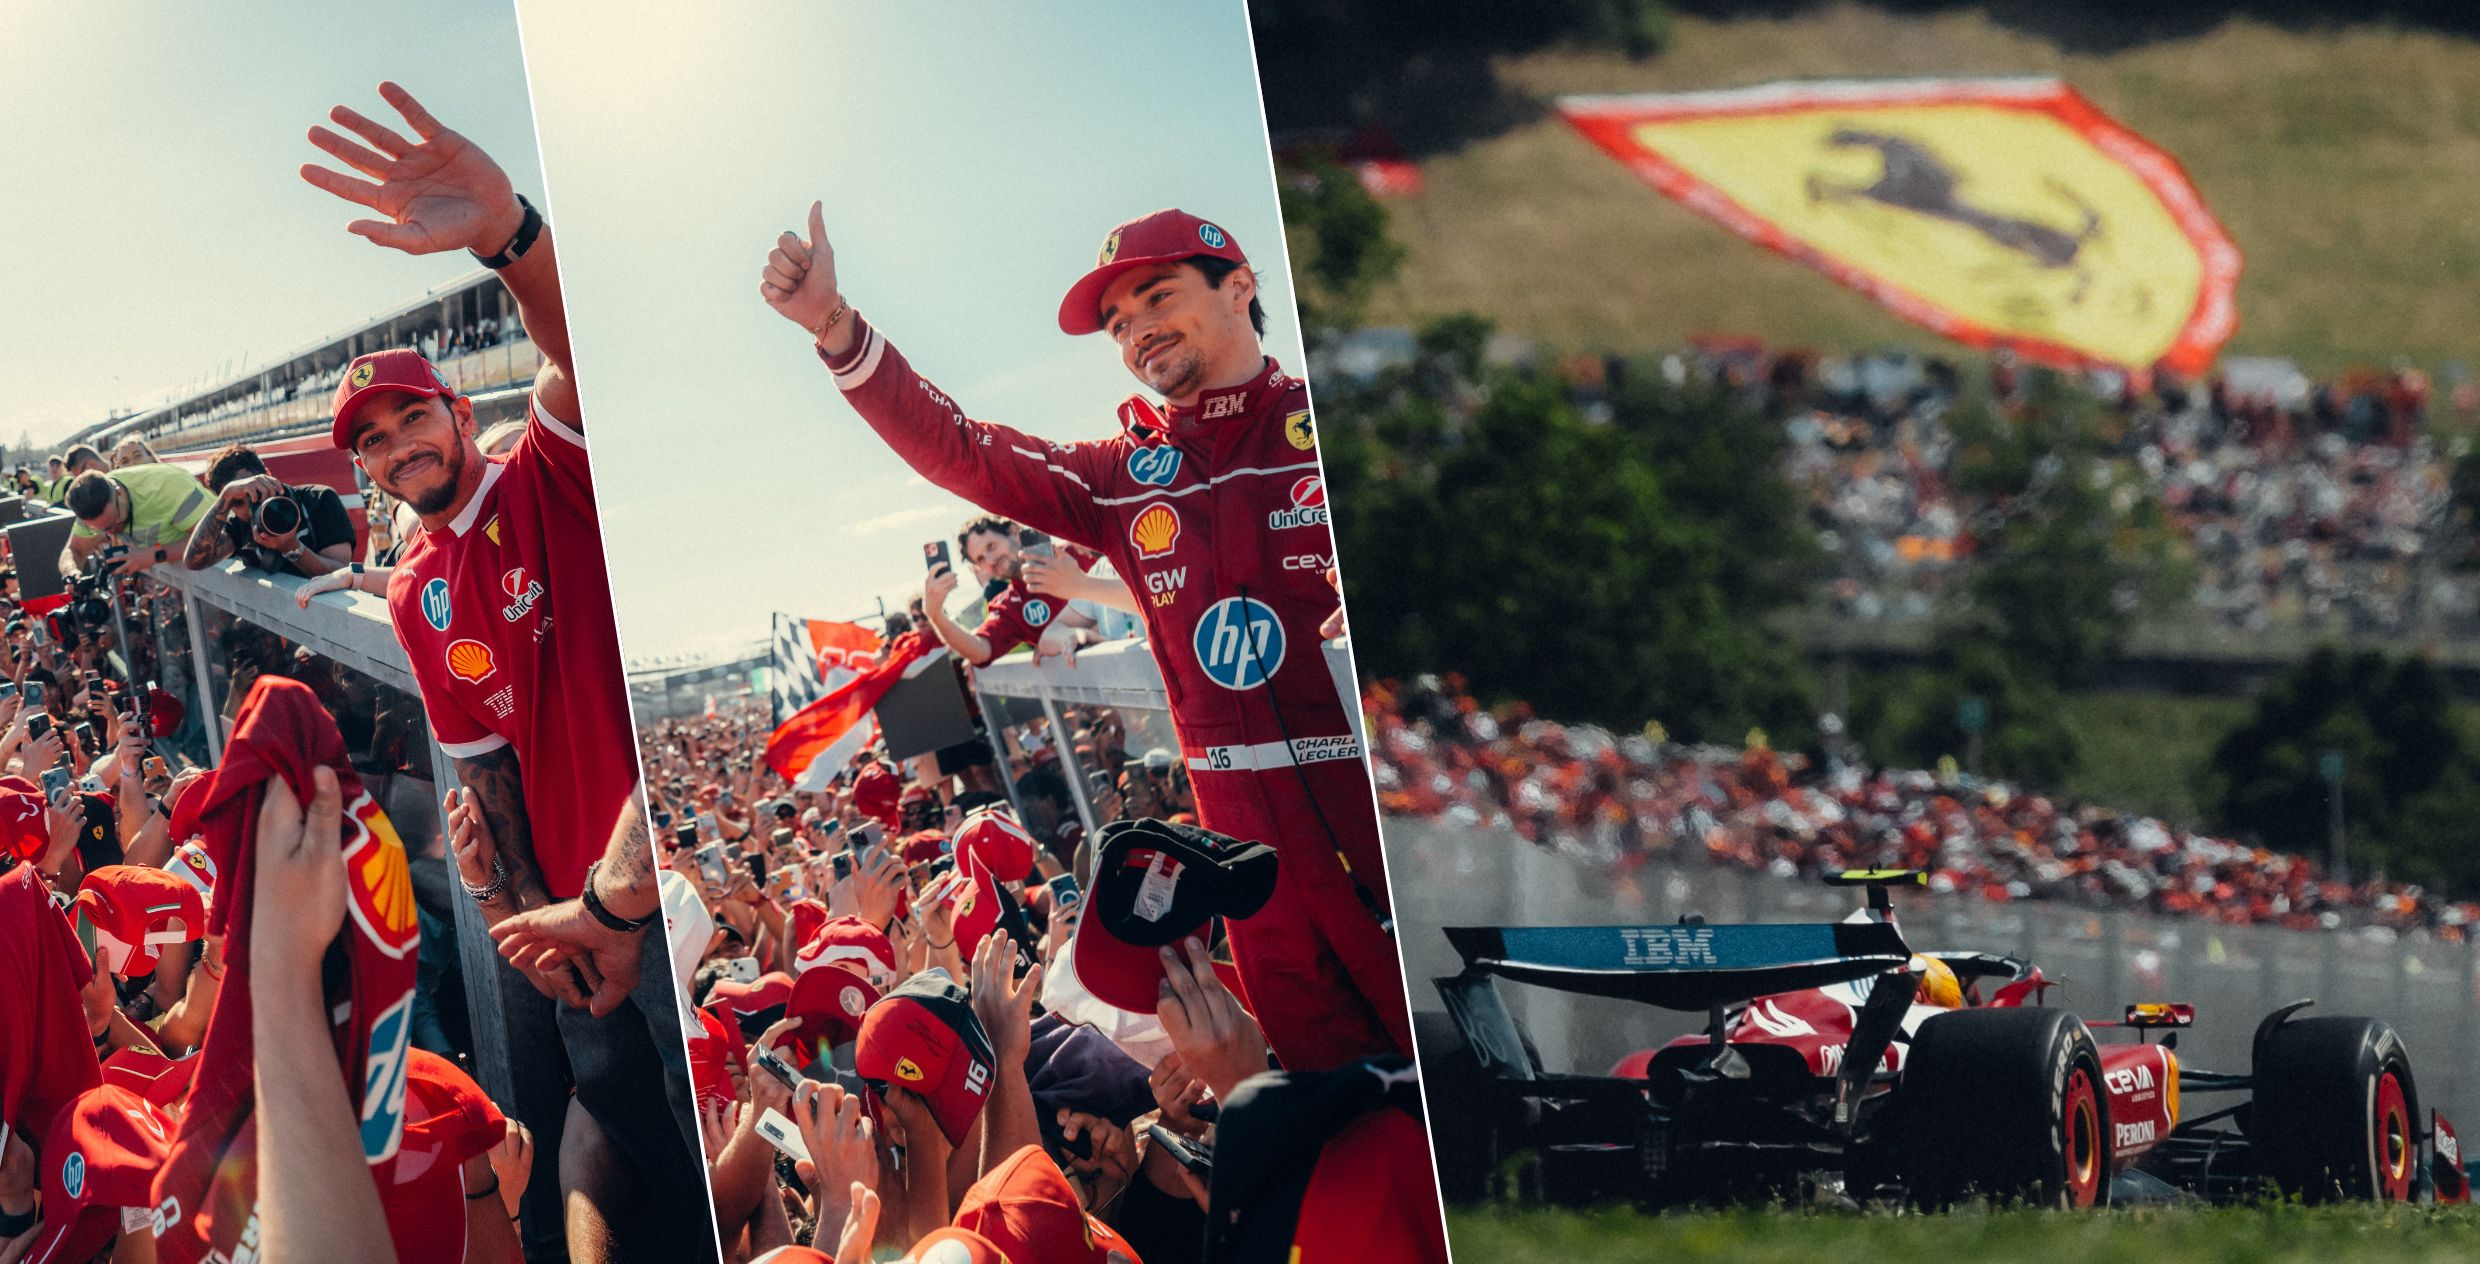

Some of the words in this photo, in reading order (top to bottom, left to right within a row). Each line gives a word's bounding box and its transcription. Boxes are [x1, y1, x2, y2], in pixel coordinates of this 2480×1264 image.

[1201, 224, 1223, 248] hp
[1202, 391, 1248, 420] IBM
[1145, 566, 1187, 593] GW
[425, 580, 452, 630] hp
[1025, 602, 1048, 626] hp
[1204, 598, 1275, 689] hp
[1210, 747, 1231, 769] 16
[1621, 929, 1717, 965] IBM
[964, 1059, 988, 1096] 16
[2052, 1032, 2073, 1121] ZERO
[2115, 1120, 2155, 1148] PERONI
[65, 1156, 83, 1198] hp
